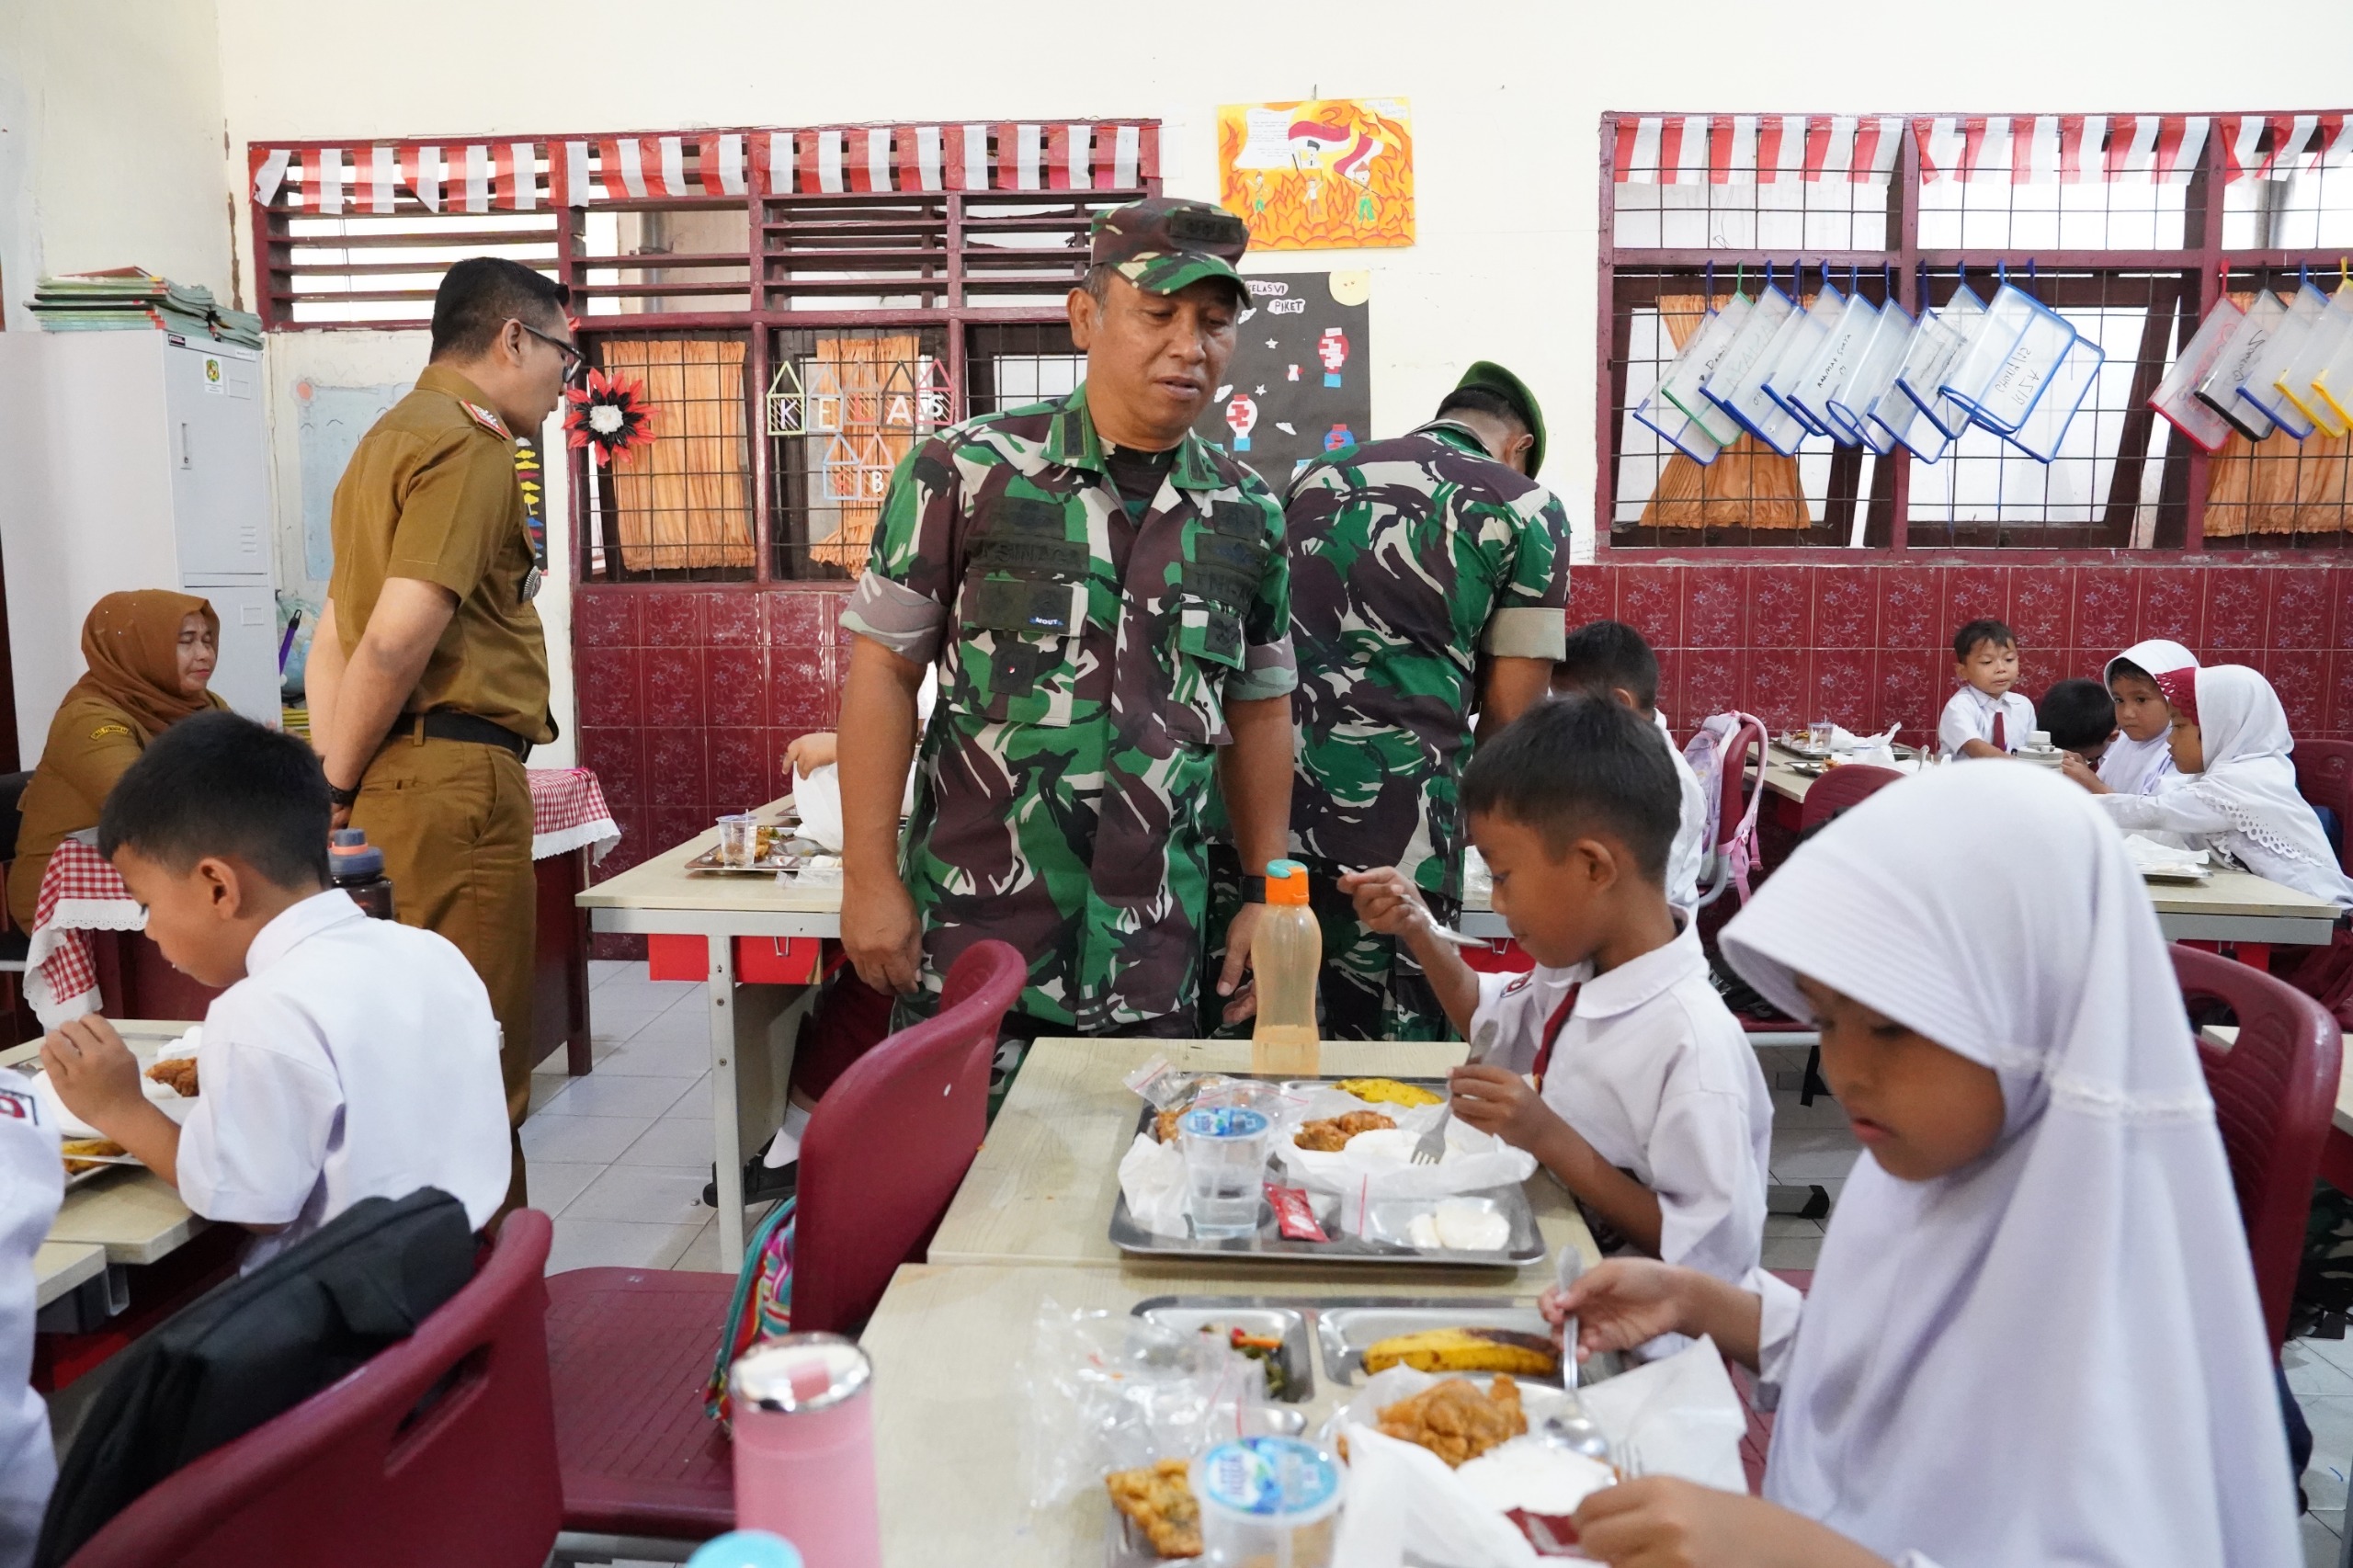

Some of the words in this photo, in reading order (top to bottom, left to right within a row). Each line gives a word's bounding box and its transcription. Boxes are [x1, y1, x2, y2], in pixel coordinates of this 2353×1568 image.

[1275, 301, 1303, 312] PIKET
[779, 394, 945, 429] KELAS
[1035, 616, 1058, 625] MOUT
